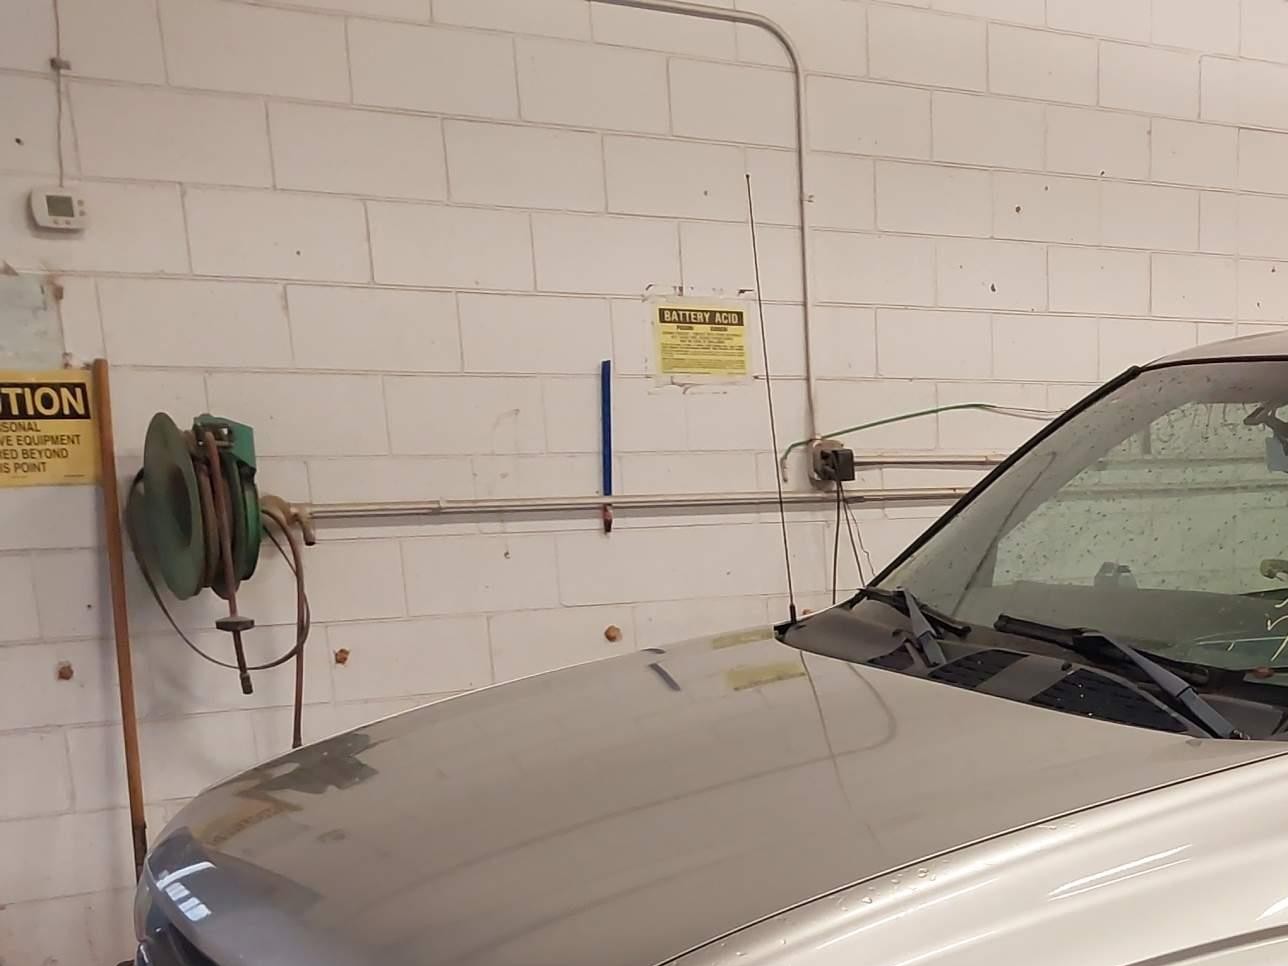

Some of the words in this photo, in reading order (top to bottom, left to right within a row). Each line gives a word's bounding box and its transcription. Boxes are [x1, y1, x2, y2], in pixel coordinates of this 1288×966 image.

[664, 310, 710, 323] BATTERY
[715, 312, 739, 324] ACID
[0, 386, 85, 416] TION
[0, 421, 41, 433] SONAL
[17, 434, 81, 446] EQUIPMENT
[22, 448, 69, 460] BEYOND
[14, 462, 47, 473] POINT
